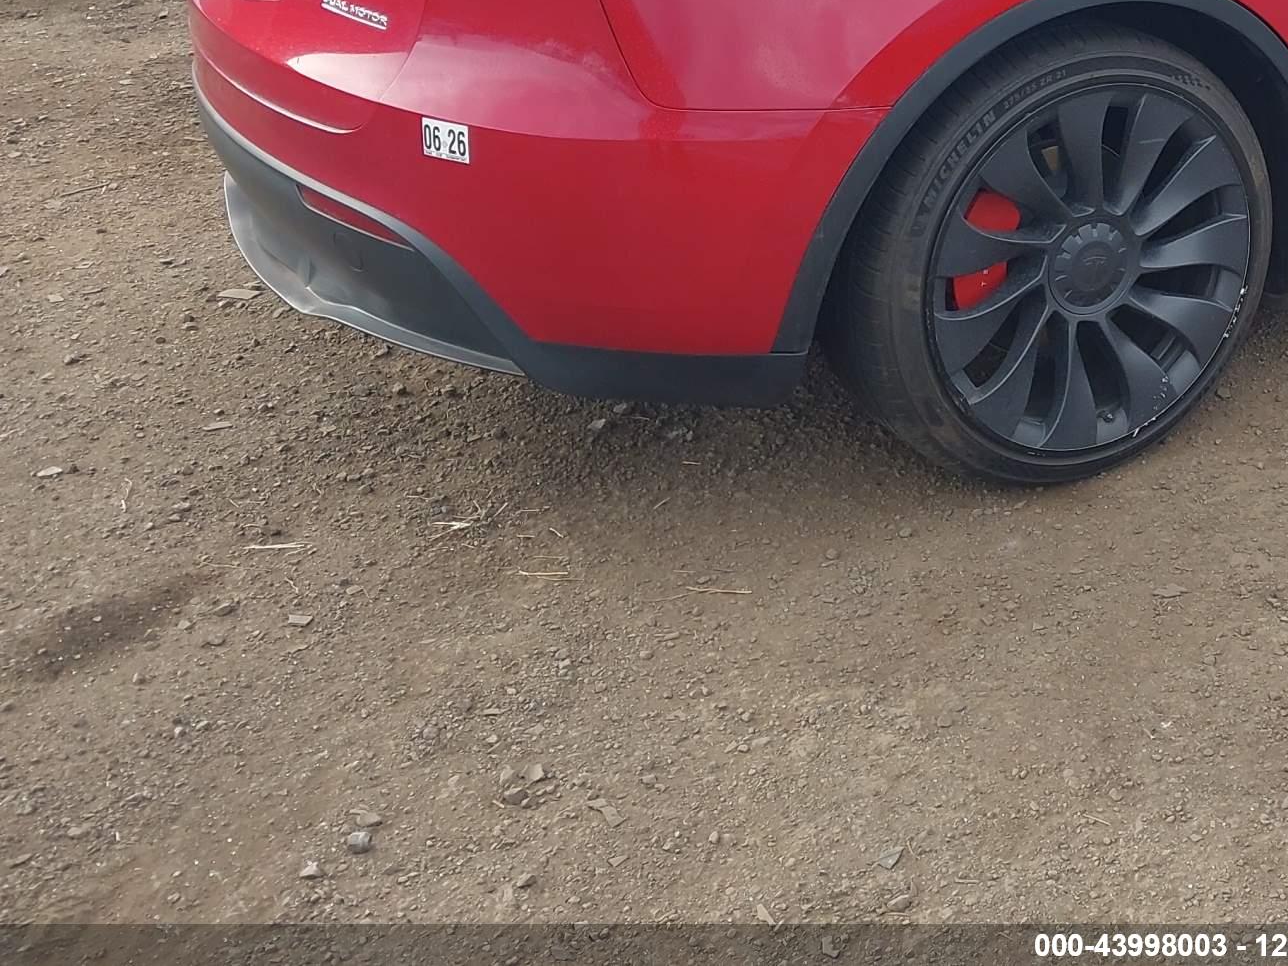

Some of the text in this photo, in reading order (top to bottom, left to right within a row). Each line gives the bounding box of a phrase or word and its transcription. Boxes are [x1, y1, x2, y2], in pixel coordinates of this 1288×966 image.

[349, 4, 388, 27] MOTOR
[423, 123, 442, 152] 06
[447, 128, 467, 157] 26
[923, 109, 996, 208] MICHELIN
